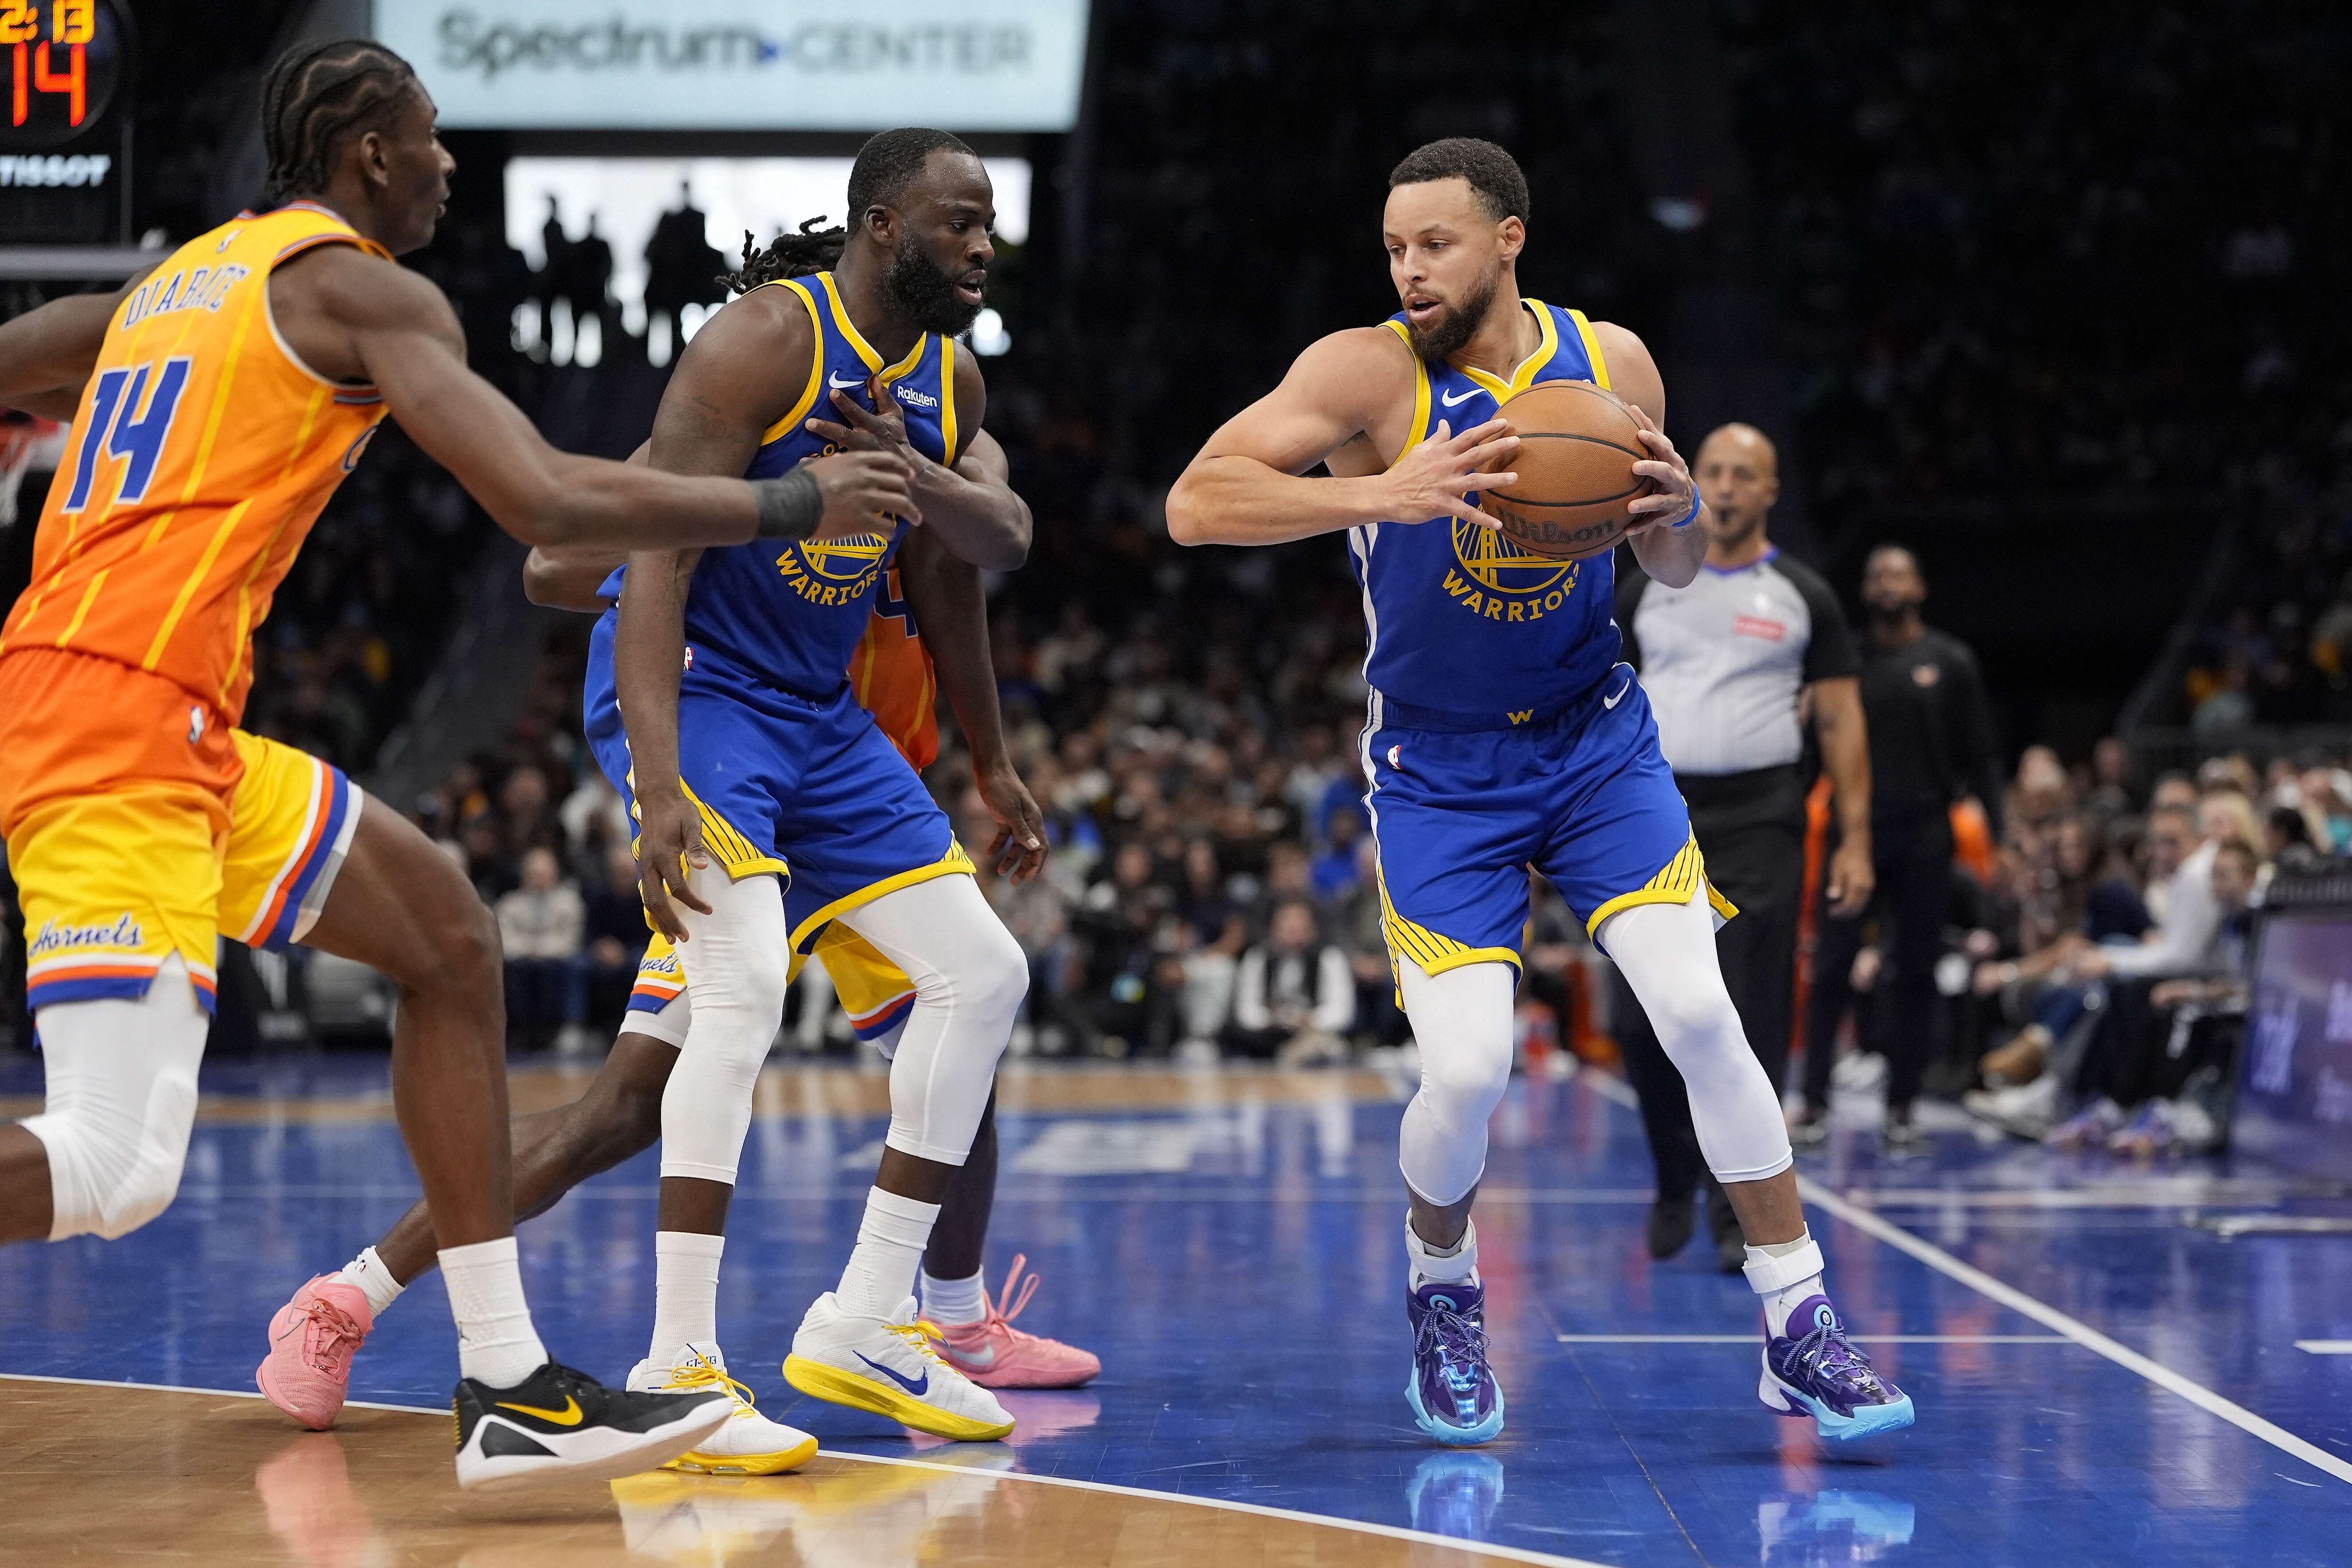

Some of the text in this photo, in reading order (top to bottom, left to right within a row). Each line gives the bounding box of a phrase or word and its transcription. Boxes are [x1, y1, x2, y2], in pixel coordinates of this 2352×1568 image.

[13, 40, 86, 127] 14
[435, 7, 1033, 85] Spectrum CENTER
[62, 355, 193, 515] 14
[898, 385, 938, 407] Rakuten
[30, 911, 143, 958] Hornets
